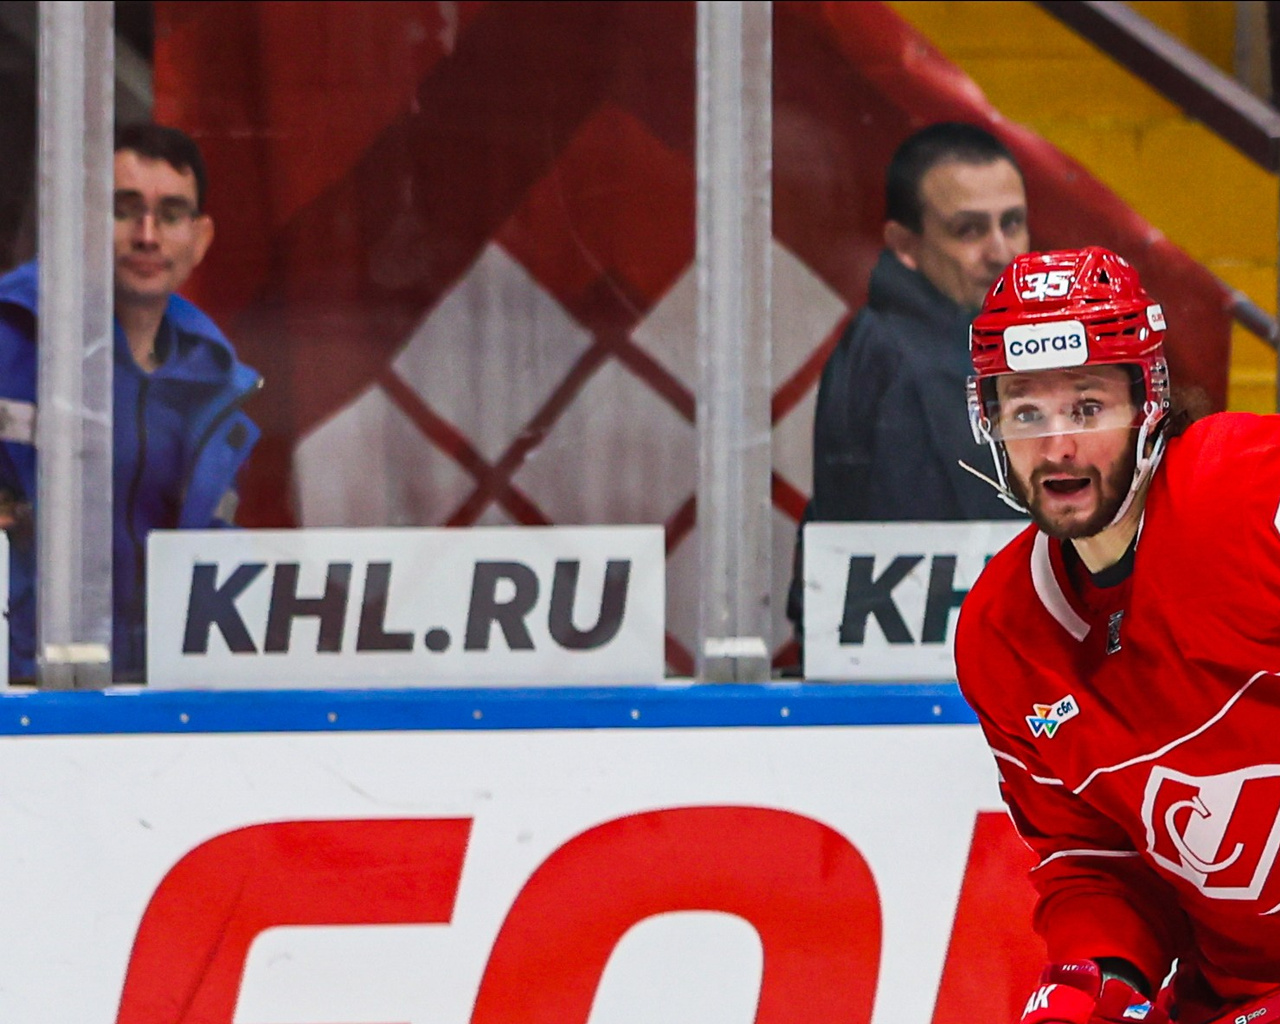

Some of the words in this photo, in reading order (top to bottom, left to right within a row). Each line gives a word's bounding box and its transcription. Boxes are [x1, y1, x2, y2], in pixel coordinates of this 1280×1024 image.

[1021, 270, 1075, 302] 35
[1009, 333, 1082, 356] согаз
[181, 559, 632, 655] KHL.RU
